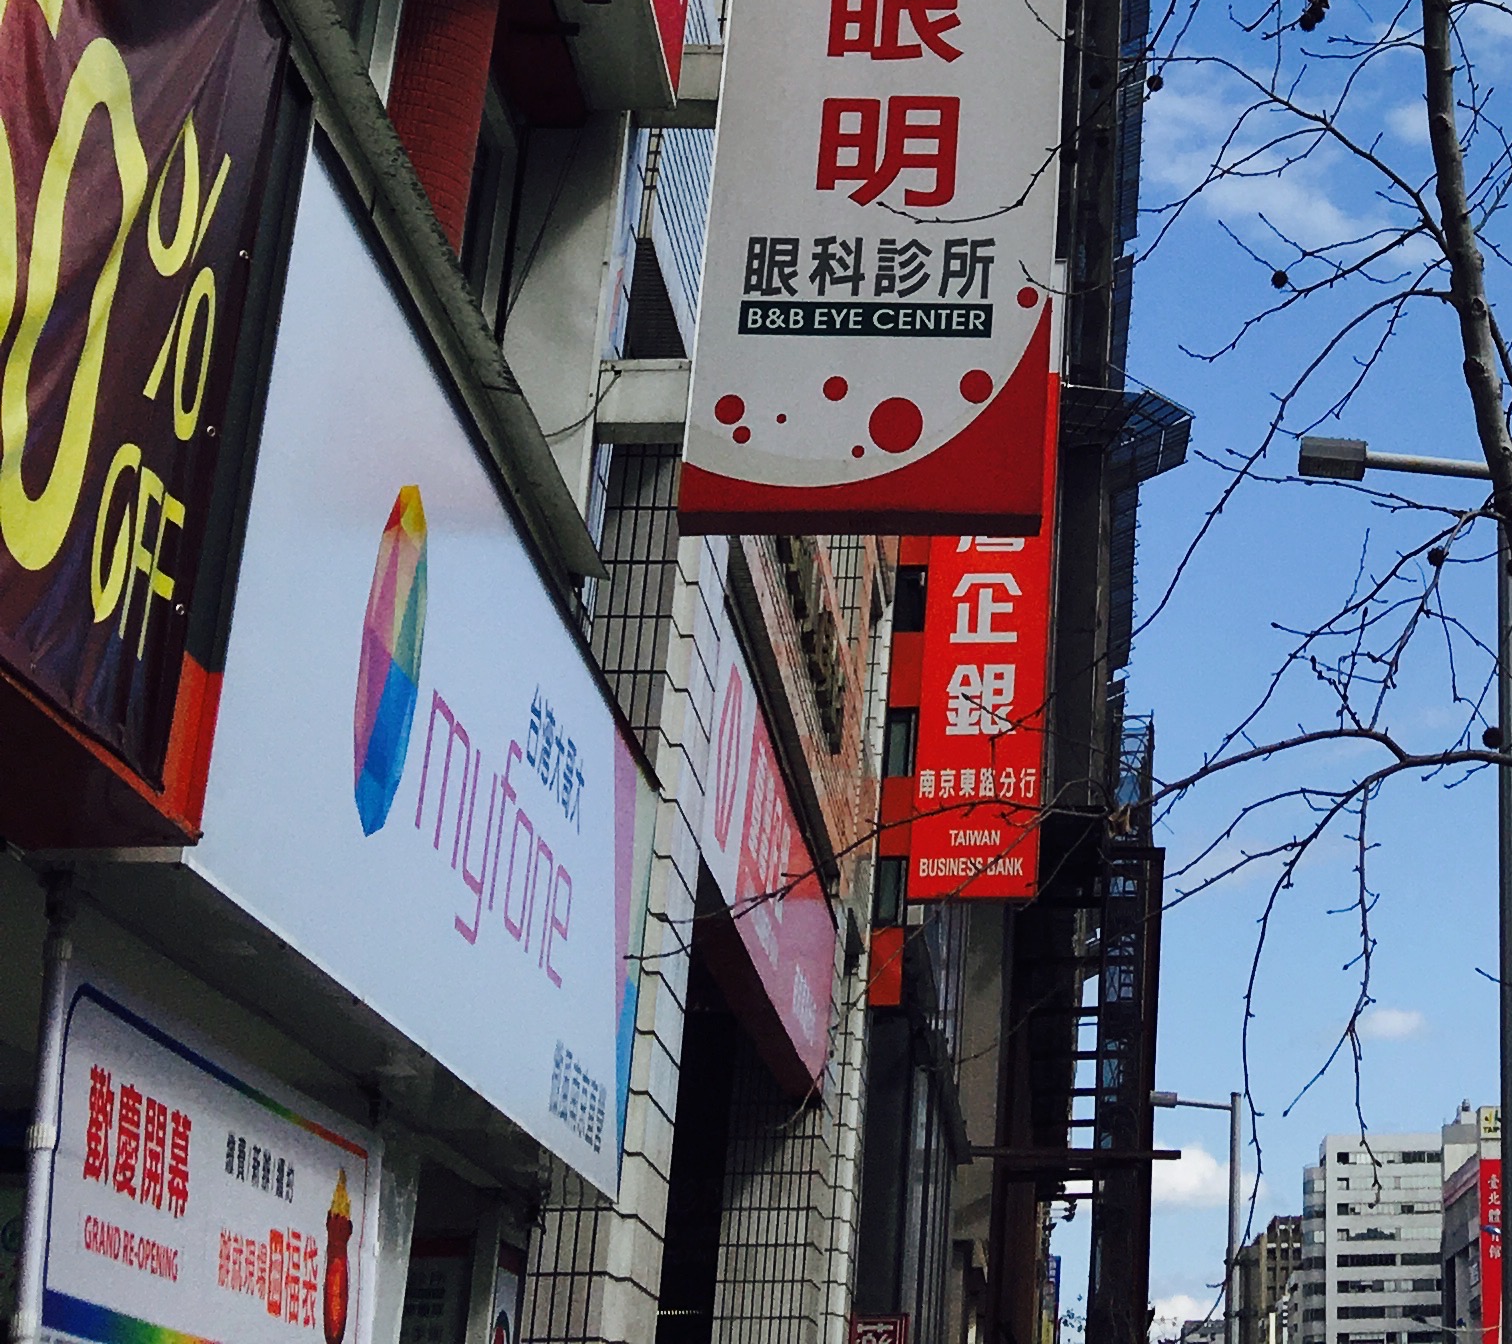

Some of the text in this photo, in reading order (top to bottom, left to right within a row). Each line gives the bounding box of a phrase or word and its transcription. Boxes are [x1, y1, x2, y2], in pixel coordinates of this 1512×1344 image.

[743, 235, 996, 301] 眼科診所
[747, 307, 986, 332] B&B EYE CENTER
[92, 445, 185, 660] OFF
[526, 682, 586, 836] 台灣大哥大
[919, 767, 1036, 799] 南京東路分行
[415, 689, 574, 988] myfone
[919, 857, 1023, 877] BUSINESS BANK
[949, 830, 1000, 846] TAIWAN
[83, 1064, 193, 1219] 歡慶開幕
[83, 1216, 121, 1261] GRAND
[122, 1228, 179, 1283] RE-OPENING
[1487, 1174, 1502, 1259] 臺北體館
